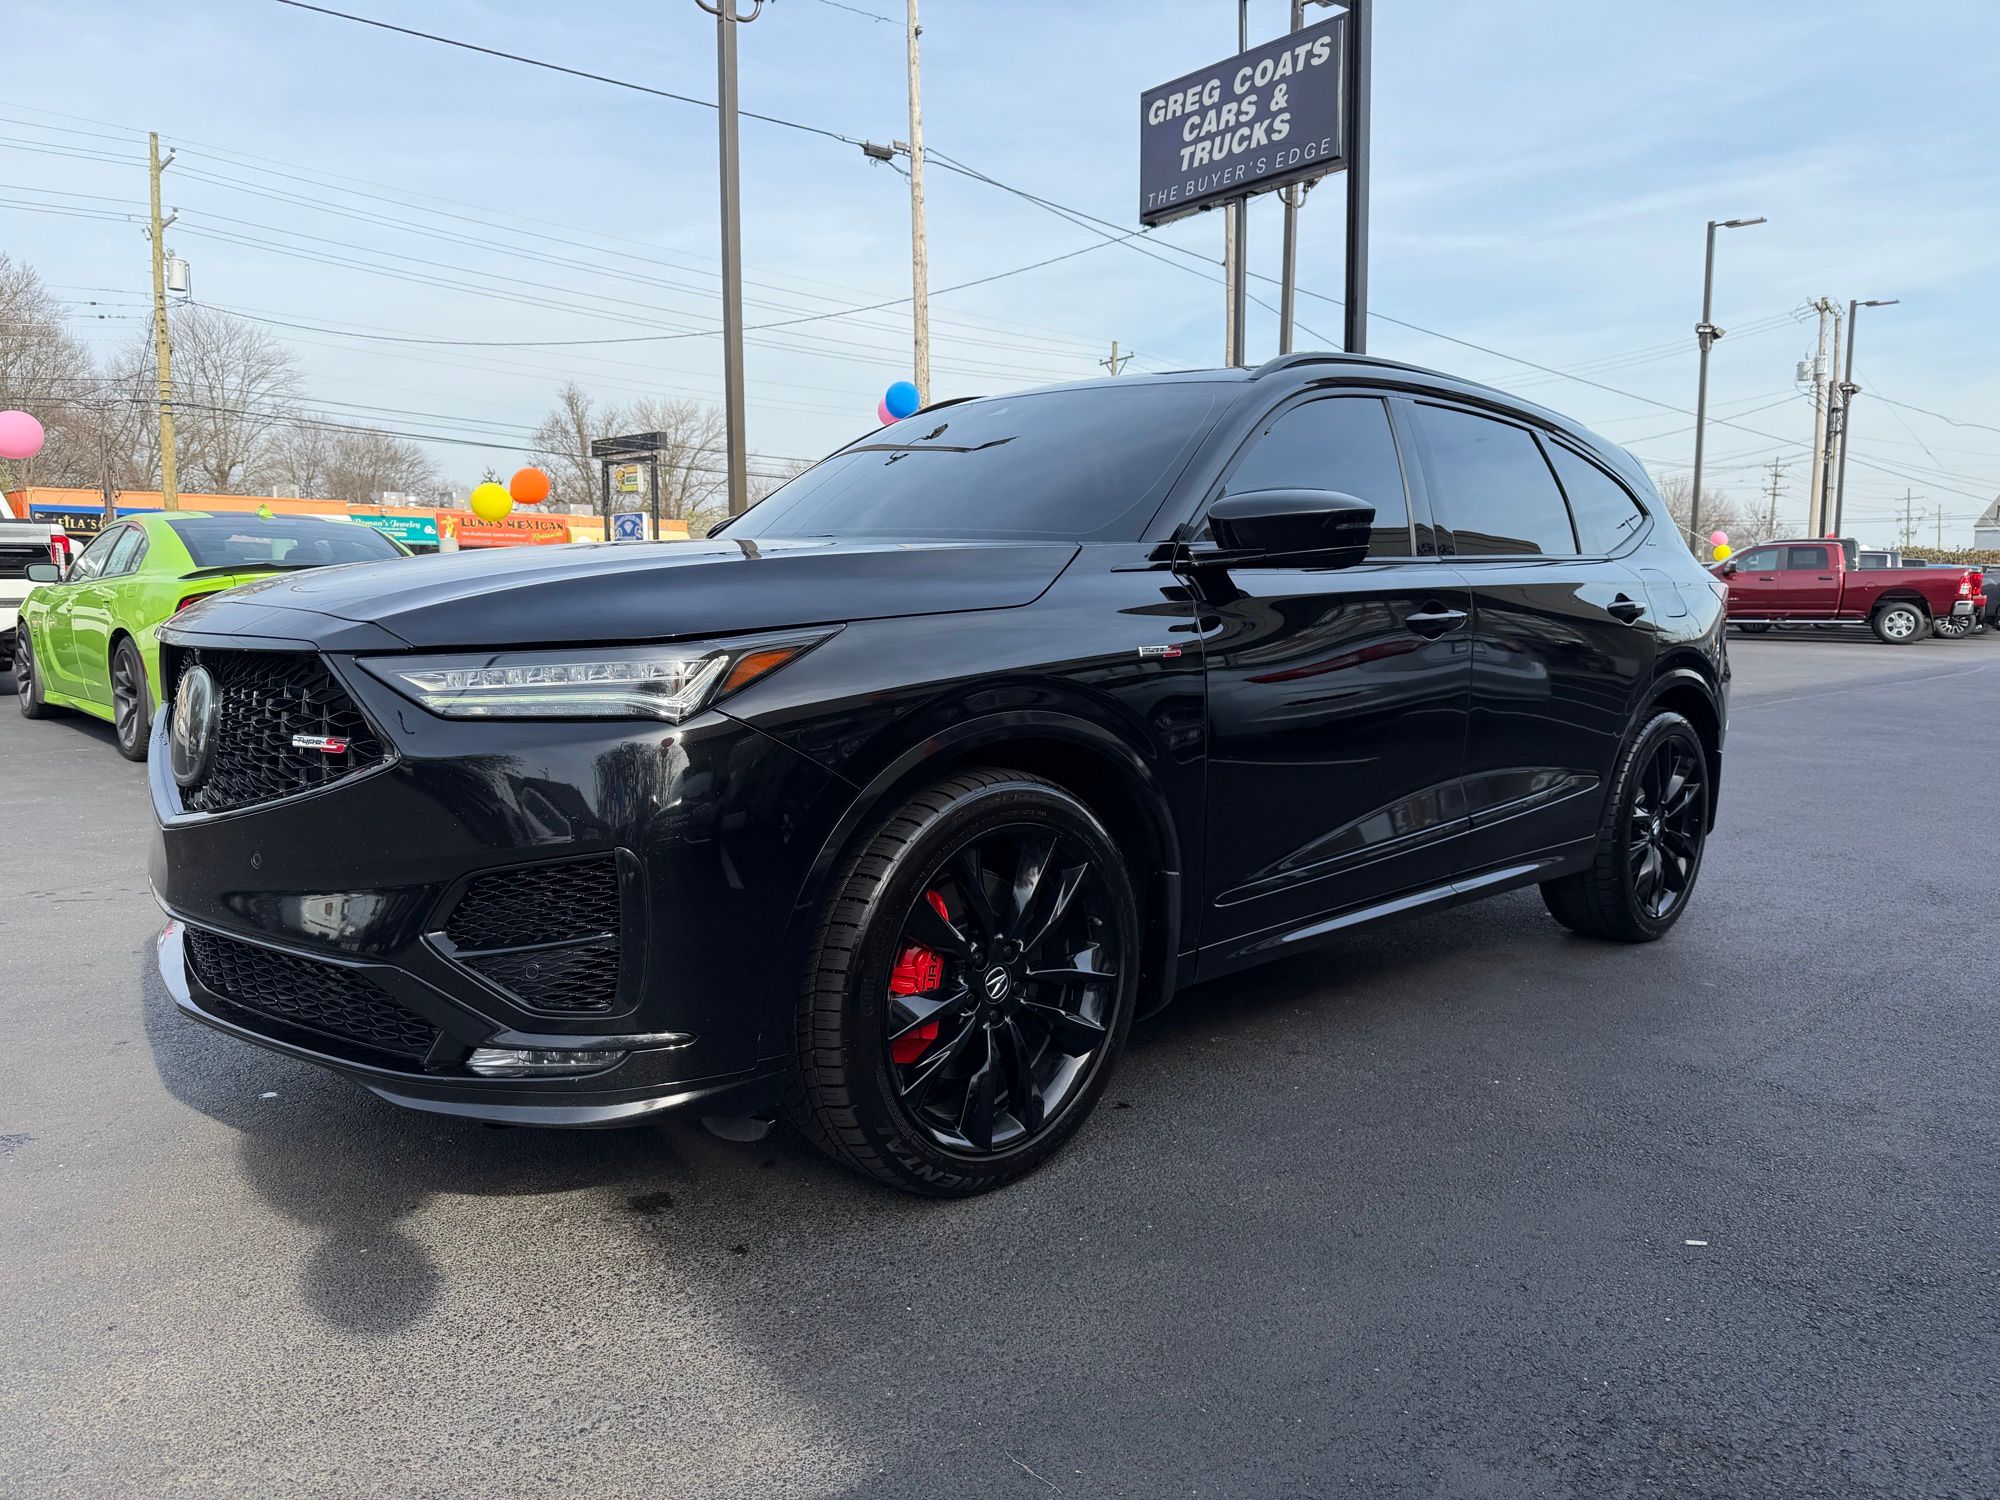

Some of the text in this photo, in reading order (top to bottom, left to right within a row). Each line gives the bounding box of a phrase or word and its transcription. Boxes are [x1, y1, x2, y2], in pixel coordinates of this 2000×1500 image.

[1148, 35, 1332, 126] GREG COATS
[1180, 112, 1291, 172] TRUCKS
[1182, 83, 1289, 142] CARS &
[1148, 137, 1331, 208] THE BUYER'S EDGE
[53, 515, 97, 530] EILA'S
[461, 517, 564, 531] LUNA'S MEXICAN
